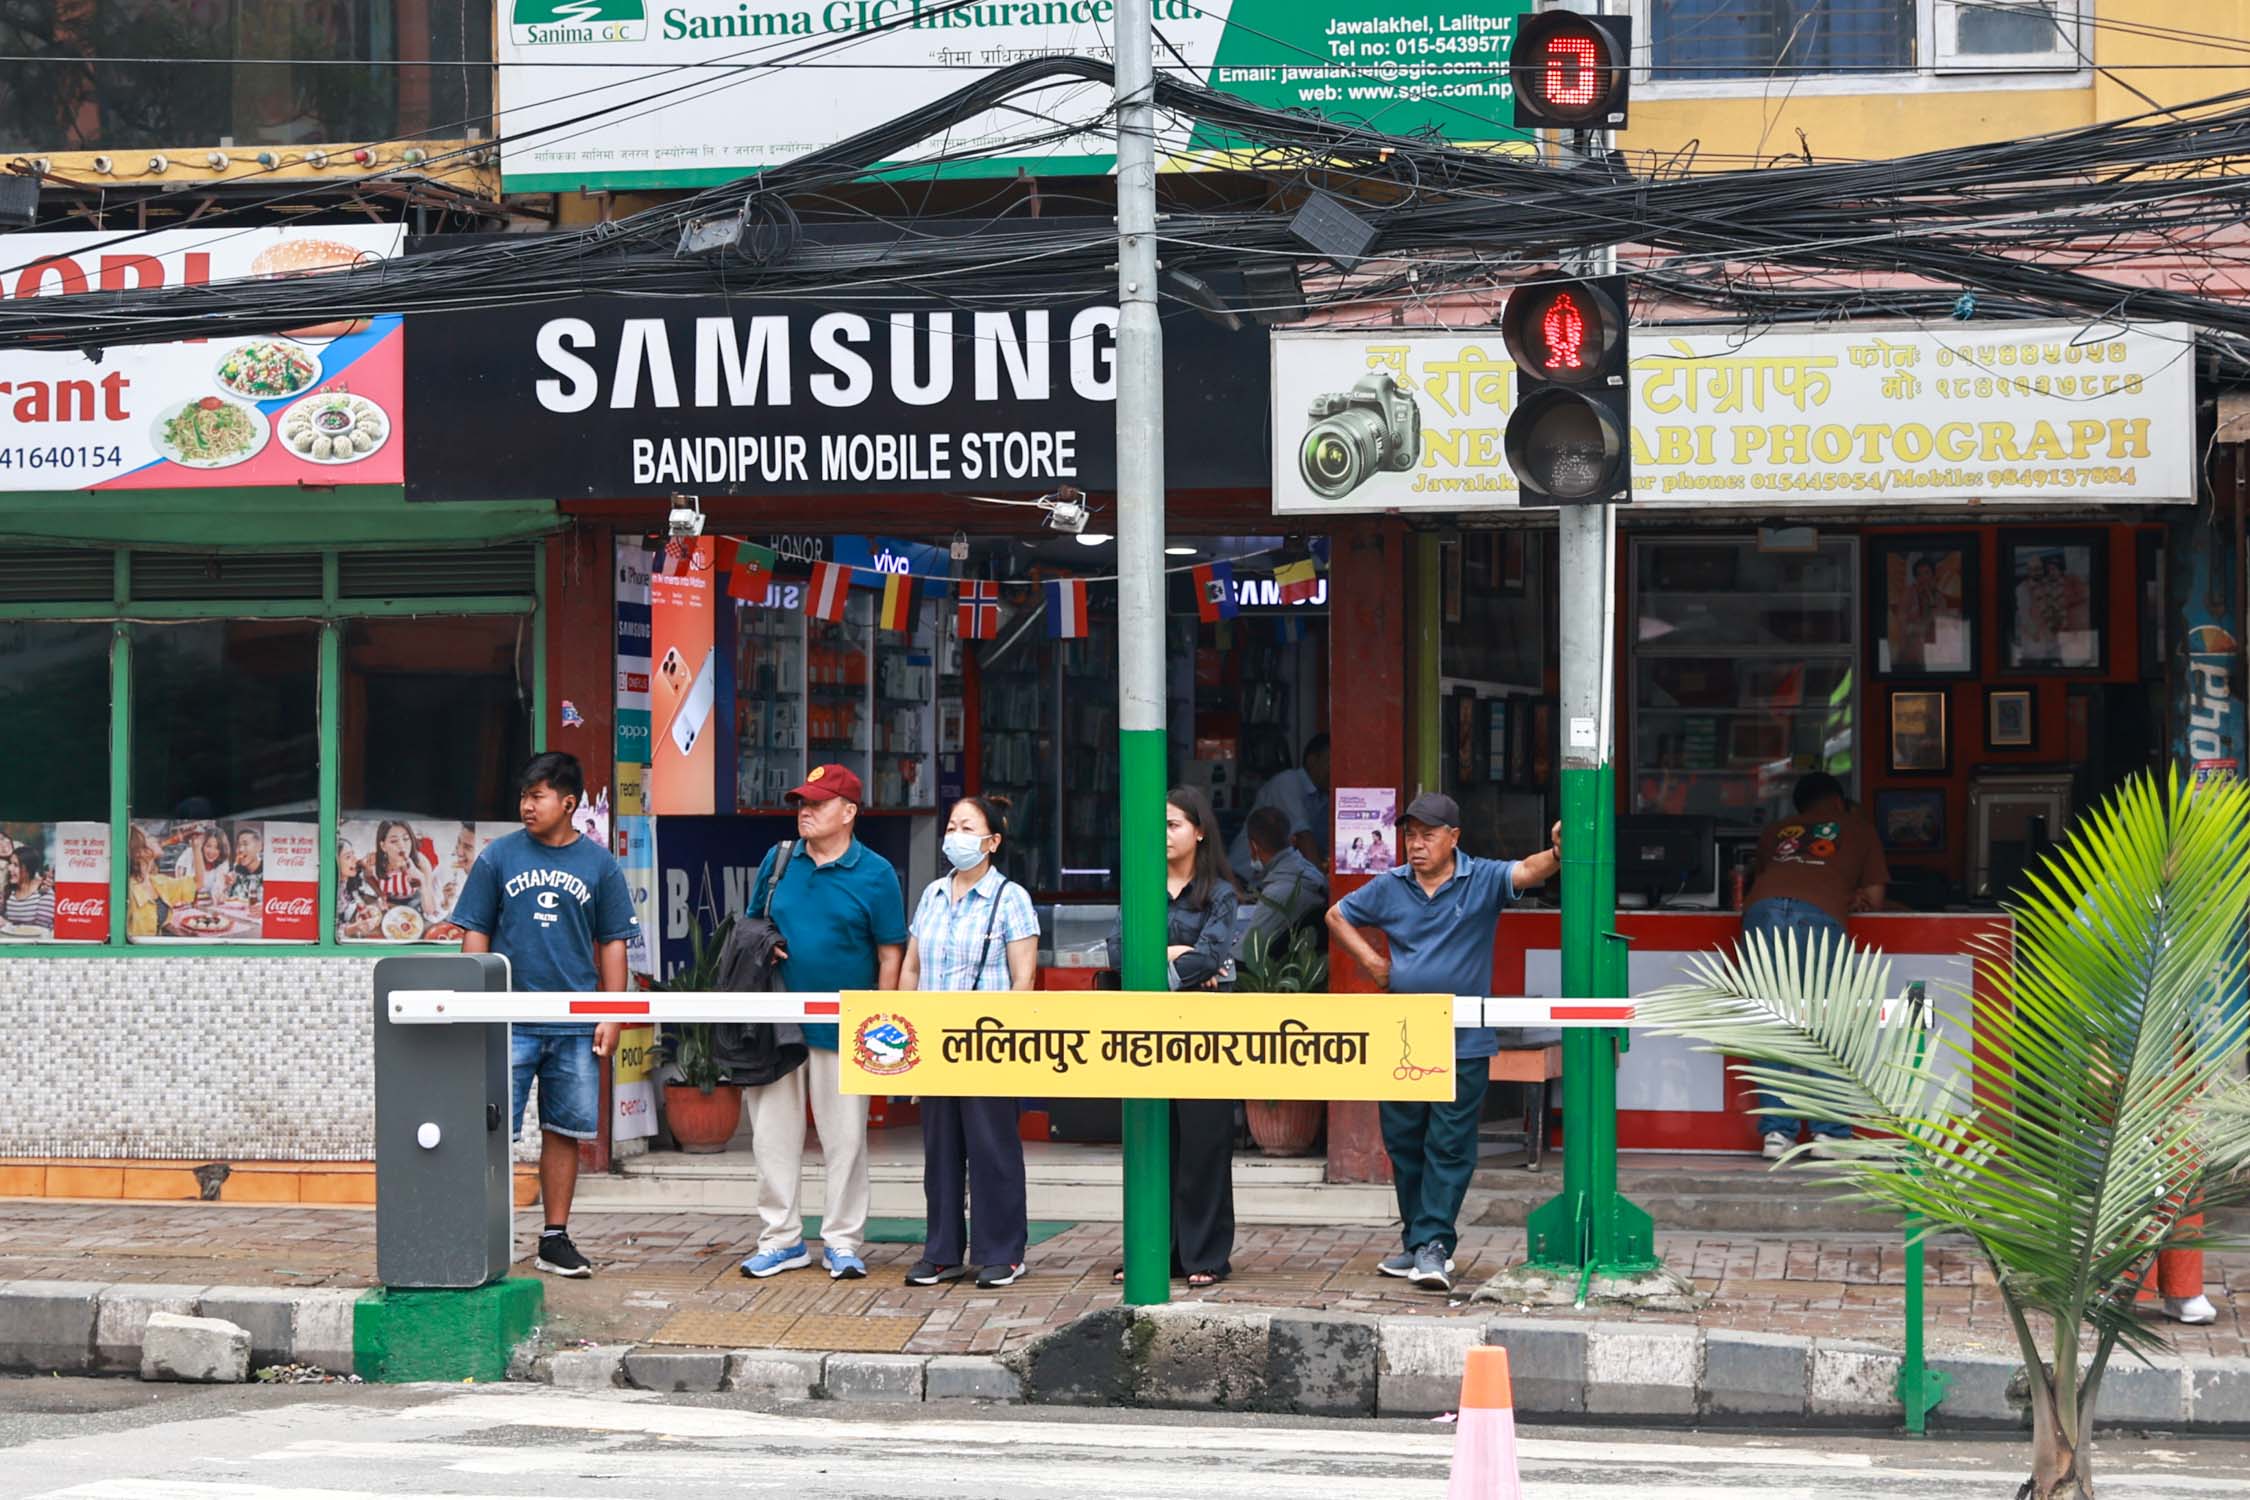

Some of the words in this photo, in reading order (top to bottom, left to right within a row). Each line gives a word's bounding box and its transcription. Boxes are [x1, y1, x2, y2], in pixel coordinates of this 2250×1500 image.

[527, 24, 593, 44] Sanima
[663, 3, 814, 40] Sanima
[822, 0, 903, 34] GIC
[911, 0, 1114, 30] Insurance
[1152, 0, 1202, 21] td.
[1325, 17, 1434, 35] Jawalakhel,
[1439, 15, 1511, 34] Lalitpur
[1328, 40, 1356, 57] Tel
[1361, 42, 1390, 56] no:
[1395, 36, 1511, 55] 015-5439577
[1218, 65, 1277, 82] Email:
[1280, 60, 1511, 84] jawalakhel@sgic.com.np
[1299, 85, 1342, 102] web:
[1348, 81, 1513, 101] www.sgic.com.np
[535, 306, 1117, 413] SAMSUNG
[1630, 338, 1839, 414] टोग्राफ
[0, 371, 130, 423] ant
[0, 445, 122, 469] 41640154
[633, 435, 809, 485] BANDIPUR
[821, 433, 950, 482] MOBILE
[960, 431, 1077, 478] STORE
[1420, 428, 1507, 467] NE
[1630, 425, 1717, 465] ABI
[1730, 418, 2152, 465] PHOTOGRAPH
[1412, 473, 1519, 492] Jawalak
[1663, 472, 1745, 493] phone:
[1987, 466, 2137, 489] 9849137884
[873, 548, 909, 575] vivo
[505, 868, 592, 906] CHAMPION
[666, 860, 759, 939] BAN
[942, 1016, 1090, 1073] ललितपुर
[1101, 1018, 1369, 1067] महानगरपालिका
